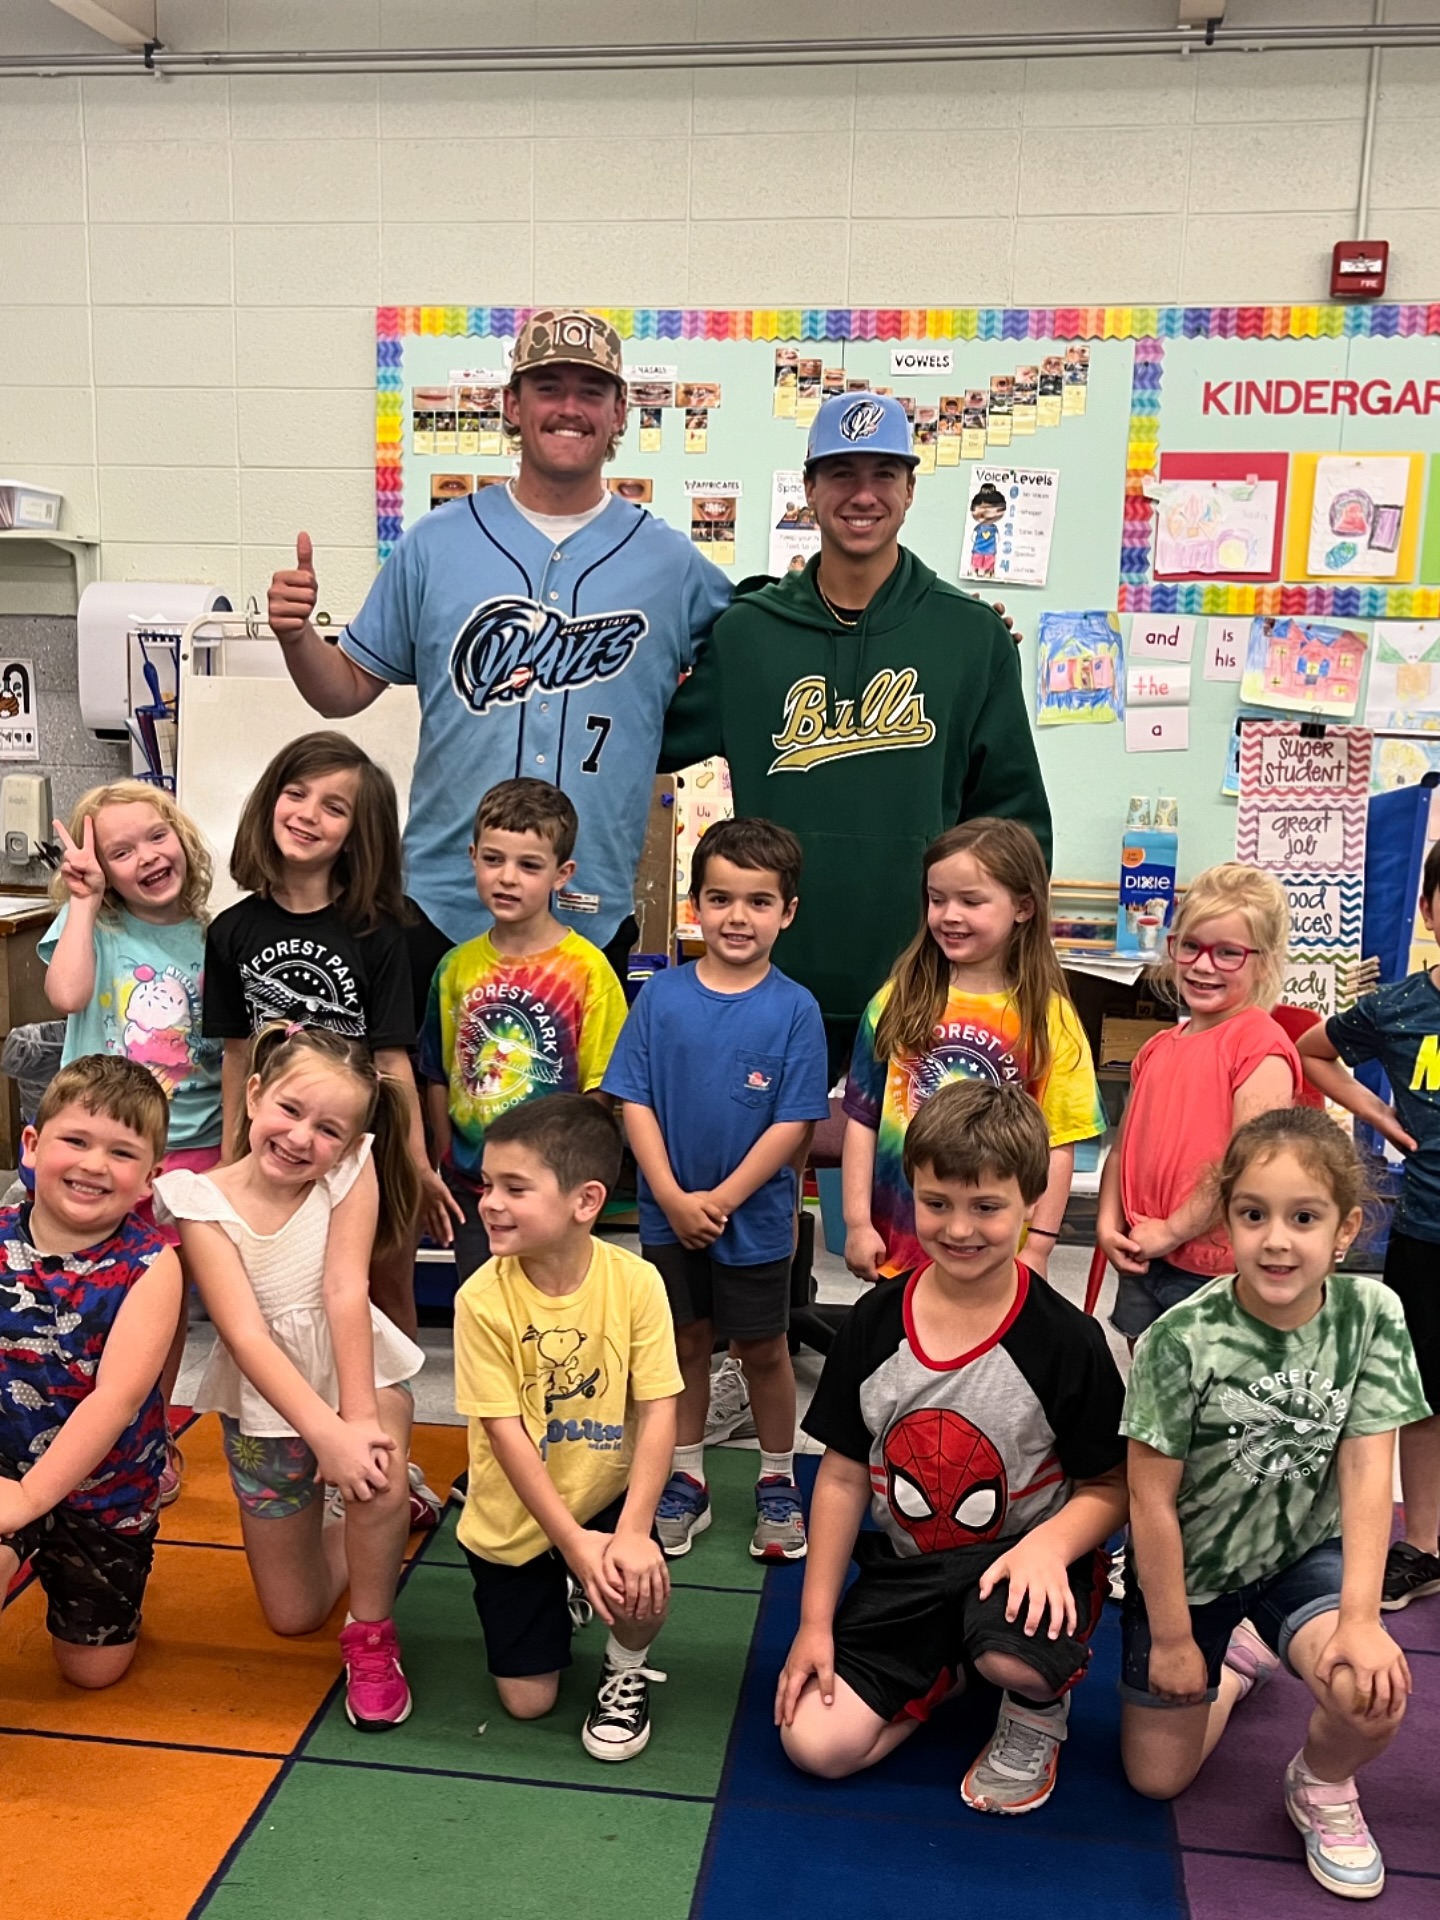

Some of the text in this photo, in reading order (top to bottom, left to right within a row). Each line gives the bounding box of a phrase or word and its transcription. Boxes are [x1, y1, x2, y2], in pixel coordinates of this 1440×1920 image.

[895, 354, 950, 368] VOWELS
[777, 483, 803, 494] Spac
[976, 469, 1053, 486] Voice Levels
[560, 616, 631, 636] OCEAN STATE
[1145, 624, 1180, 647] and
[1222, 628, 1234, 642] is
[470, 605, 646, 711] WAVES
[1214, 646, 1236, 667] his
[1133, 675, 1169, 696] the
[772, 668, 930, 750] Bulls
[1151, 724, 1162, 737] a
[581, 715, 611, 773] 7
[697, 806, 711, 818] Uu
[1284, 834, 1318, 860] job
[1288, 885, 1327, 910] ood
[1290, 912, 1333, 935] ices
[251, 938, 359, 1006] FOREST PARK
[1283, 970, 1327, 1000] ady
[462, 983, 558, 1053] FOREST PARK
[933, 1023, 1002, 1052] OREST
[1248, 1368, 1320, 1398] FORET
